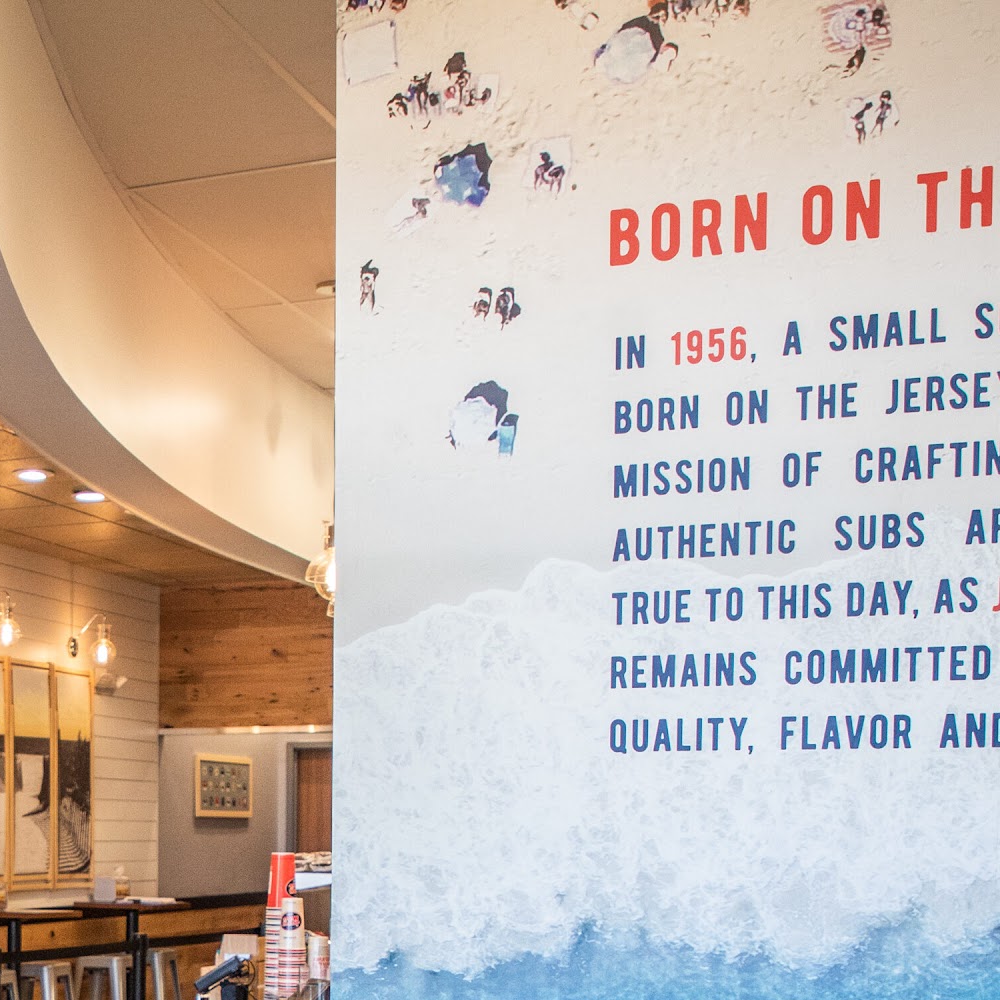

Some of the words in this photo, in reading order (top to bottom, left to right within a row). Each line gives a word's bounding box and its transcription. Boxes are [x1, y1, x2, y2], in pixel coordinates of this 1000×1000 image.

[609, 192, 768, 267] BORN
[802, 178, 881, 246] ON
[615, 335, 646, 370] IN
[671, 326, 757, 365] 1956,
[783, 321, 802, 356] A
[829, 308, 946, 351] SMALL
[975, 303, 1000, 339] S
[614, 394, 700, 434] BORN
[726, 389, 769, 426] ON
[796, 382, 858, 421] THE
[886, 370, 1000, 415] JERSE
[613, 456, 751, 498] MISSION
[783, 451, 823, 488] OF
[612, 520, 796, 562] AUTHENTIC
[835, 511, 925, 551] SUBS
[612, 589, 691, 626] TRUE
[706, 586, 744, 622] TO
[758, 583, 832, 621] THIS
[847, 580, 919, 619] DAY,
[934, 576, 979, 615] AS
[610, 651, 757, 690] REMAINS
[784, 644, 992, 686] COMMITTED
[609, 717, 755, 755] QUALITY,
[780, 713, 912, 752] FLAVOR
